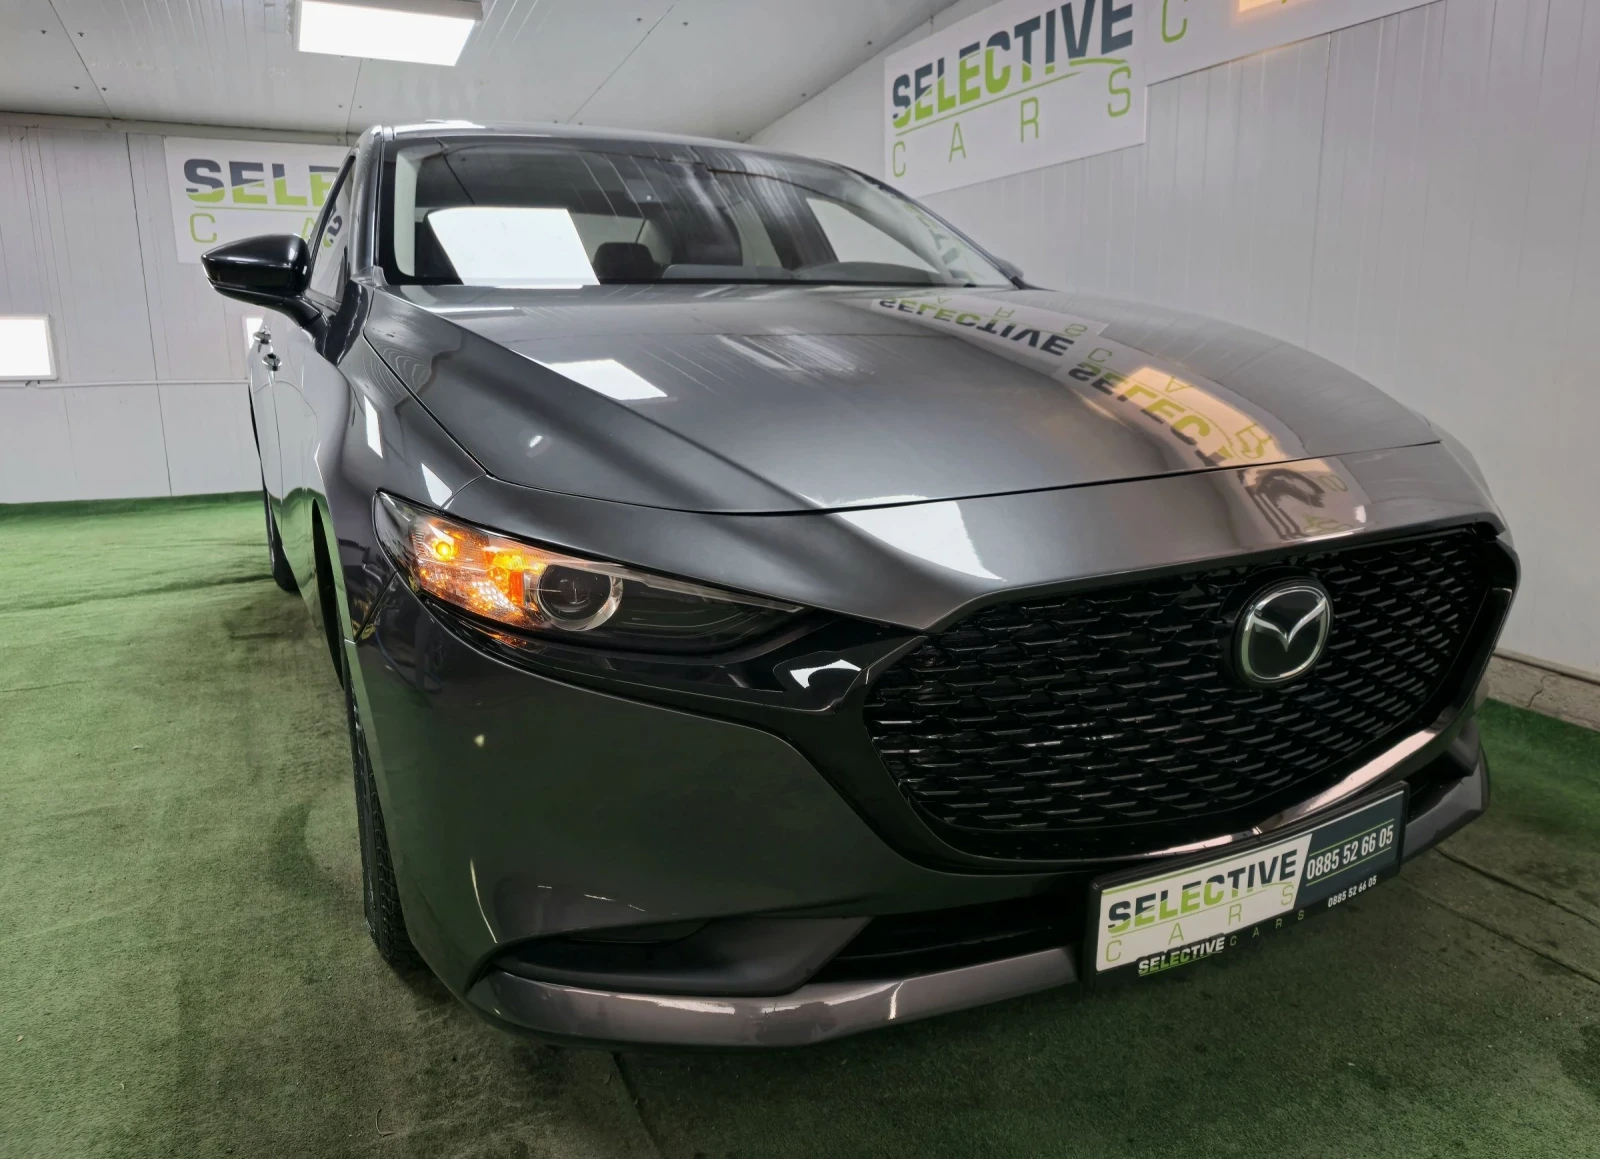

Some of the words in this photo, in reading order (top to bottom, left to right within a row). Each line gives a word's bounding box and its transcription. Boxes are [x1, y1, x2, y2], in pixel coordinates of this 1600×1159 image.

[893, 0, 1133, 128] SELECTIVE
[893, 66, 1132, 178] CARS
[1306, 848, 1340, 880] 0885
[1342, 841, 1359, 865] 52
[1361, 832, 1377, 856] 66
[1378, 824, 1394, 848] 05
[1105, 884, 1295, 963] CARS
[1107, 849, 1298, 934] SELECTIVE
[1327, 890, 1347, 908] 0885
[1348, 885, 1357, 898] 52
[1358, 880, 1367, 893] 66
[1368, 875, 1378, 888] 05
[1138, 936, 1226, 976] SELECTIVE
[1229, 909, 1305, 947] CARS
